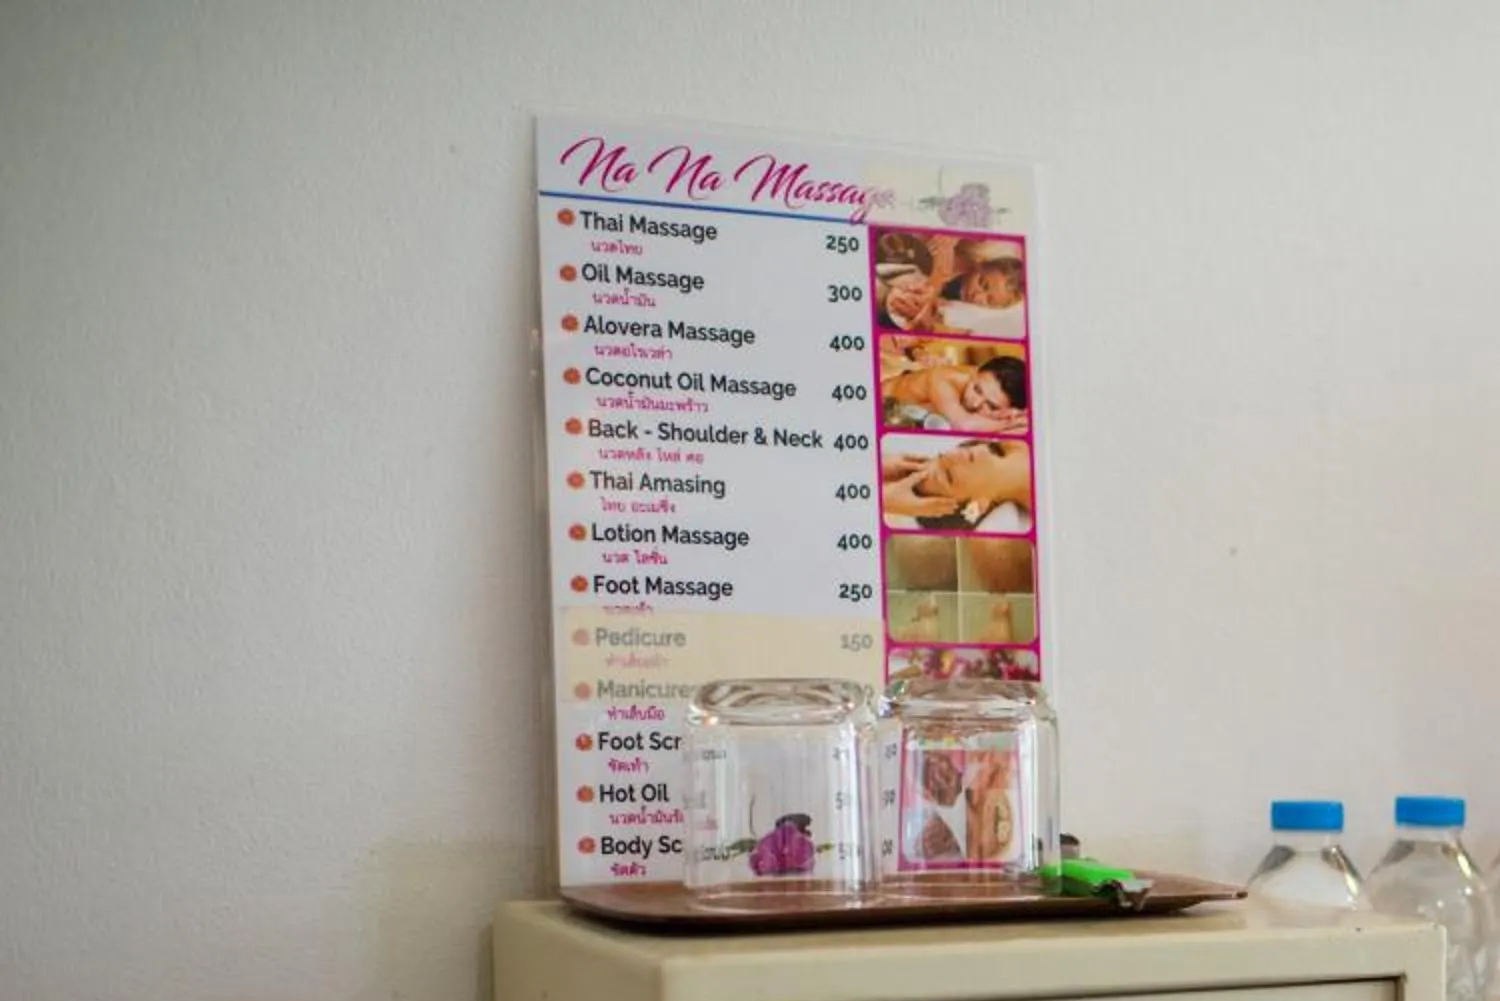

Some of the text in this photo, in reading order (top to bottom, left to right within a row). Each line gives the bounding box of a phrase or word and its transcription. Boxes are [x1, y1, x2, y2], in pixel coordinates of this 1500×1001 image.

[560, 137, 638, 193] Na
[647, 145, 724, 200] Na
[580, 210, 717, 243] Thai Massage
[826, 235, 859, 254] 250
[582, 263, 704, 294] Oil Massage
[828, 285, 862, 302] 300
[584, 315, 755, 348] Alovera Massage
[830, 336, 864, 351] 400
[586, 367, 796, 400] Coconut Oil Massage
[832, 385, 866, 401] 400
[588, 419, 638, 440] Back
[658, 422, 748, 445] Shoulder
[754, 427, 767, 446] &
[774, 429, 822, 449] Neck
[834, 434, 868, 451] 400
[590, 470, 726, 499] Thai Amasing
[835, 484, 871, 502] 400
[592, 523, 749, 550] Lotion Massage
[837, 534, 872, 550] 400
[593, 575, 733, 600] Foot Massage
[839, 584, 872, 602] 250
[596, 627, 687, 647] Pedicure
[841, 634, 873, 651] 150
[598, 731, 682, 751] Foot Scr
[600, 784, 636, 802] Hot
[641, 784, 670, 801] Oil
[601, 835, 653, 860] Body
